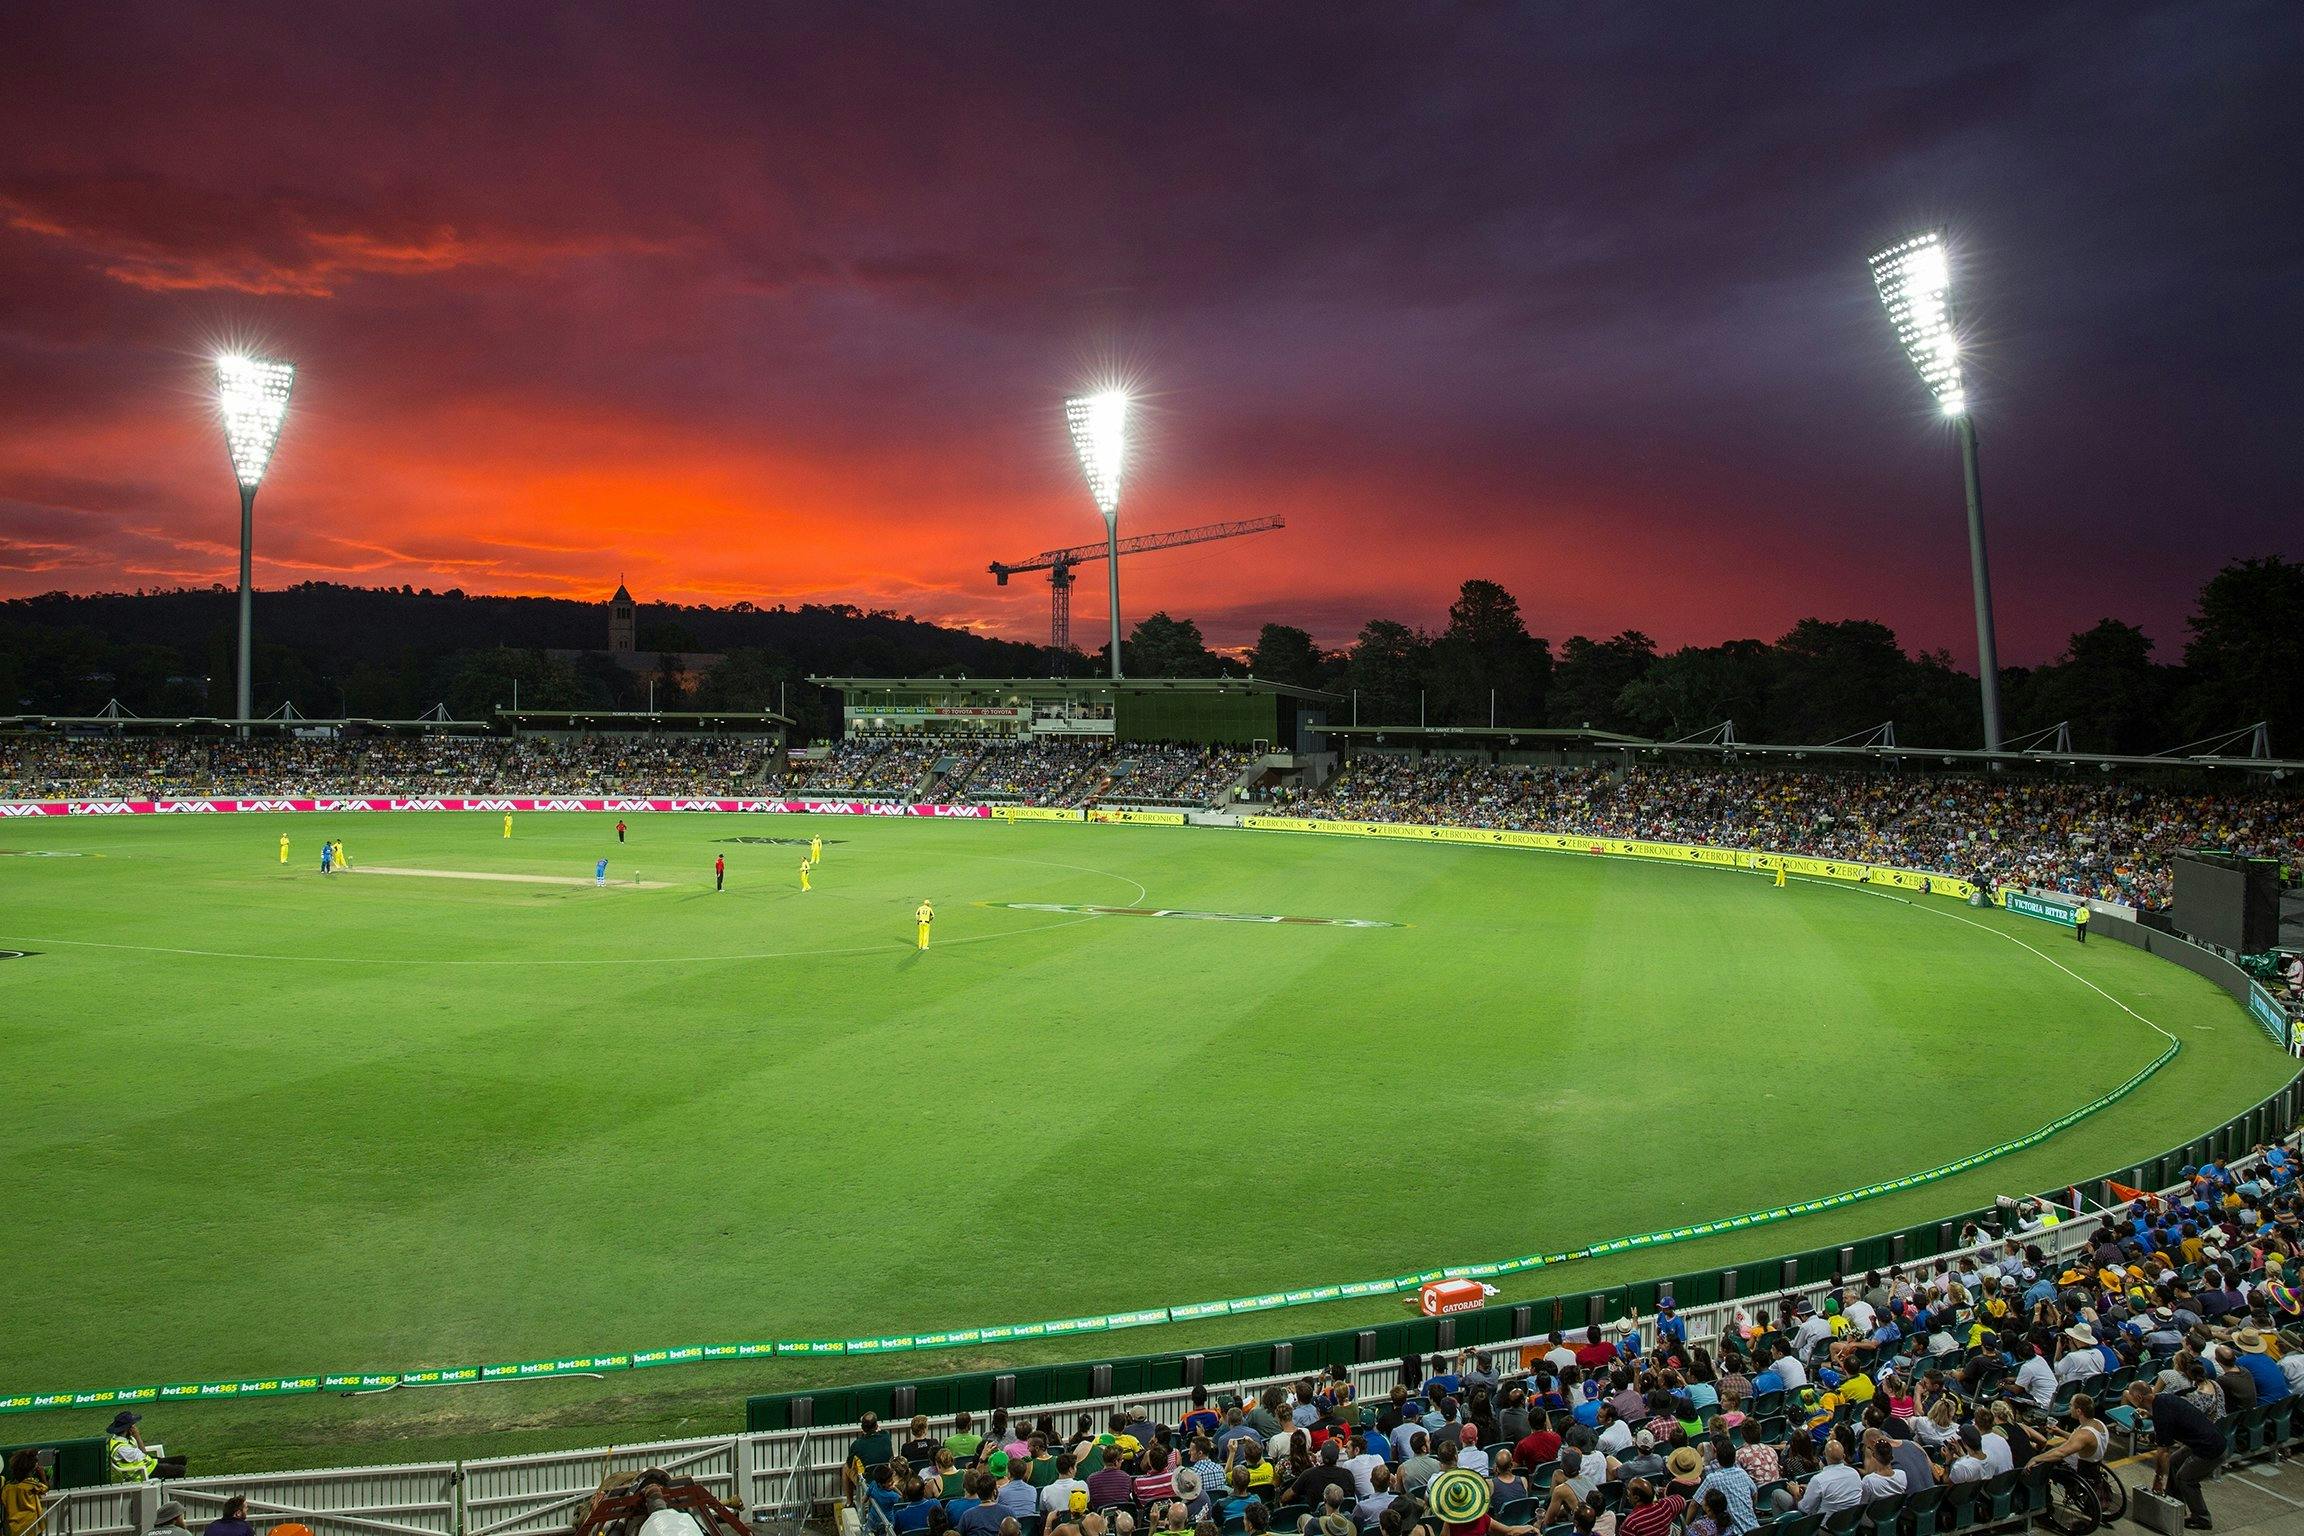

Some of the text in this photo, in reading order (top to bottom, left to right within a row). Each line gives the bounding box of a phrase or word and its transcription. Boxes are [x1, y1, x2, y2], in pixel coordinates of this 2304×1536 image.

[0, 805, 47, 816] AVA
[155, 801, 217, 813] LAVA
[237, 800, 297, 811] LAVA
[391, 800, 446, 810] LAVA
[464, 800, 517, 810] LAVA
[534, 800, 588, 810] LAVA
[604, 800, 655, 810] LAVA
[671, 801, 723, 811] LAVA
[805, 803, 855, 814] LAVA
[870, 804, 919, 815] LAVA
[934, 806, 982, 817] LAVA
[1132, 814, 1180, 823] ZEBRONICS
[1256, 819, 1302, 828] ZEBRONICS
[1317, 823, 1363, 832] ZEBRONICS
[1378, 826, 1424, 836] ZEBRONICS
[1439, 830, 1486, 840] ZEBRONICS
[1502, 834, 1550, 845] ZEBRONICS
[1633, 845, 1683, 857] ZEBRONICS
[1700, 850, 1750, 864] ZEBRONICS
[2014, 899, 2044, 914] VICTORIA
[2045, 907, 2068, 919] BITTER
[1442, 1299, 1484, 1313] GATORADE
[0, 1398, 30, 1407] et365
[35, 1394, 73, 1404] bet365
[76, 1392, 114, 1402] bet365
[118, 1389, 155, 1399] bet365
[162, 1386, 198, 1395] bet365
[202, 1384, 237, 1393] bet365
[241, 1381, 277, 1391] bet365
[281, 1379, 317, 1389] bet365
[326, 1377, 360, 1385] bet365
[363, 1376, 396, 1385] bet365
[404, 1373, 438, 1382] bet365
[442, 1370, 477, 1379] bet365
[483, 1366, 517, 1376] bet365
[521, 1363, 554, 1373] bet365
[557, 1359, 591, 1369] bet365
[594, 1356, 627, 1366] bet365
[634, 1352, 666, 1362] bet365
[670, 1347, 702, 1358] bet365
[705, 1346, 737, 1355] bet365
[740, 1345, 771, 1353] bet365
[779, 1343, 809, 1351] bet365
[813, 1342, 843, 1351] bet365
[847, 1340, 879, 1349] bet365
[881, 1337, 912, 1347] bet365
[915, 1335, 946, 1344] bet365
[948, 1332, 979, 1341] bet365
[981, 1329, 1012, 1338] bet365
[1014, 1325, 1043, 1334] bet365
[1046, 1322, 1075, 1332] bet365
[1077, 1319, 1105, 1328] bet365
[1108, 1315, 1136, 1325] bet365
[1139, 1311, 1165, 1321] bet365
[1171, 1307, 1199, 1317] bet365
[1201, 1303, 1228, 1312] bet365
[1231, 1300, 1257, 1309] bet365
[1259, 1296, 1284, 1306] bet365
[1287, 1291, 1312, 1301] bet365
[1313, 1288, 1339, 1298] bet365
[1342, 1285, 1367, 1294] bet365
[1369, 1281, 1395, 1291] bet365
[1397, 1276, 1419, 1286] bet365
[1420, 1270, 1442, 1281] bet365
[1444, 1268, 1470, 1277] bet365
[1472, 1265, 1497, 1274] bet365
[1499, 1261, 1519, 1271] bet365
[1520, 1256, 1543, 1266] bet365
